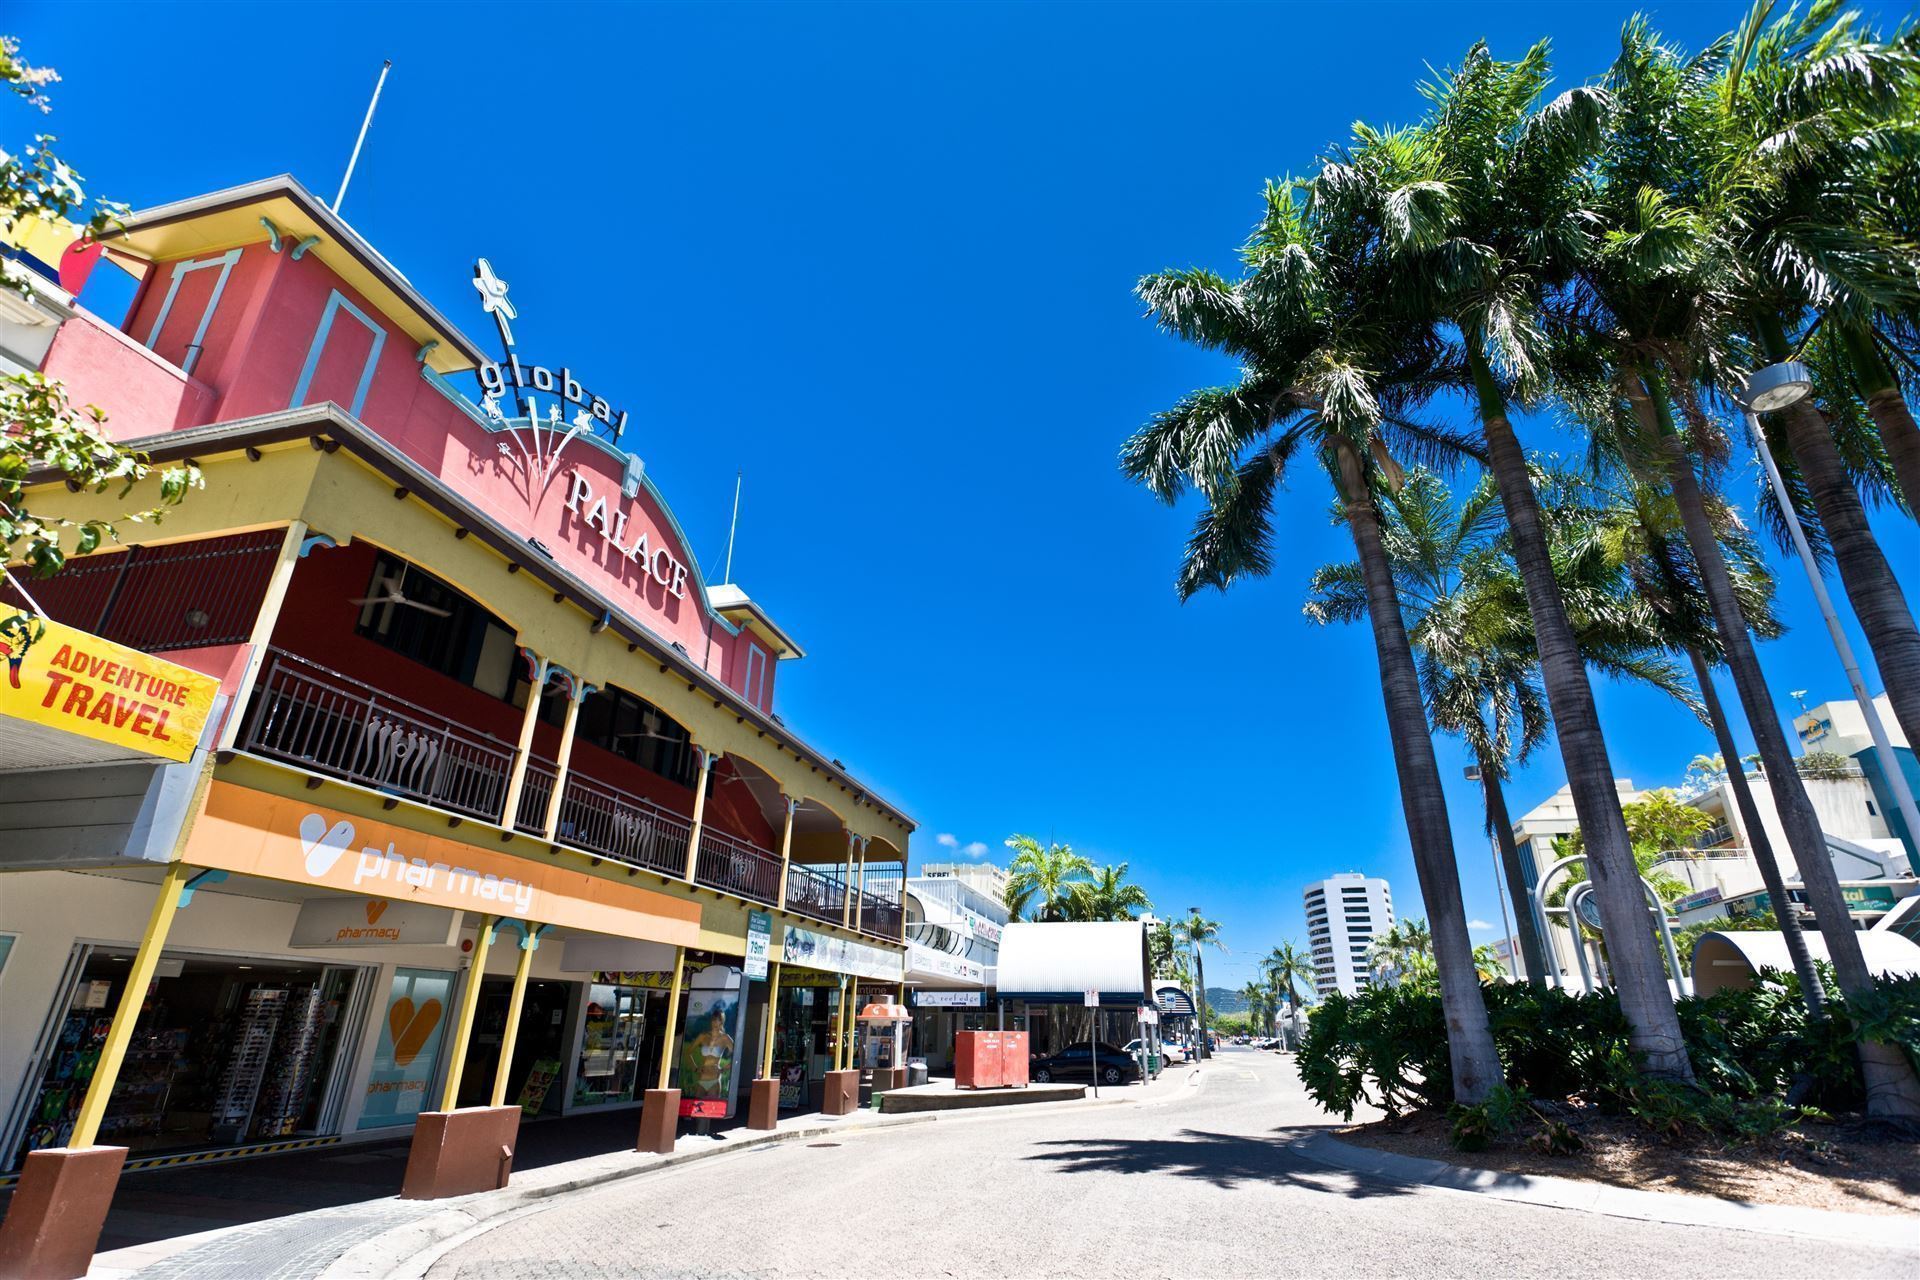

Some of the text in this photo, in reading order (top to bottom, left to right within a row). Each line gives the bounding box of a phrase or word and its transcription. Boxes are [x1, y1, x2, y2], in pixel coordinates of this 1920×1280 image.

[480, 354, 628, 436] global
[566, 469, 688, 600] PALACE
[41, 671, 171, 741] TRAVEL
[50, 644, 190, 707] ADVENTURE
[353, 842, 533, 914] pharmacy
[336, 926, 401, 941] pharmacy
[367, 1079, 428, 1094] pharmacy
